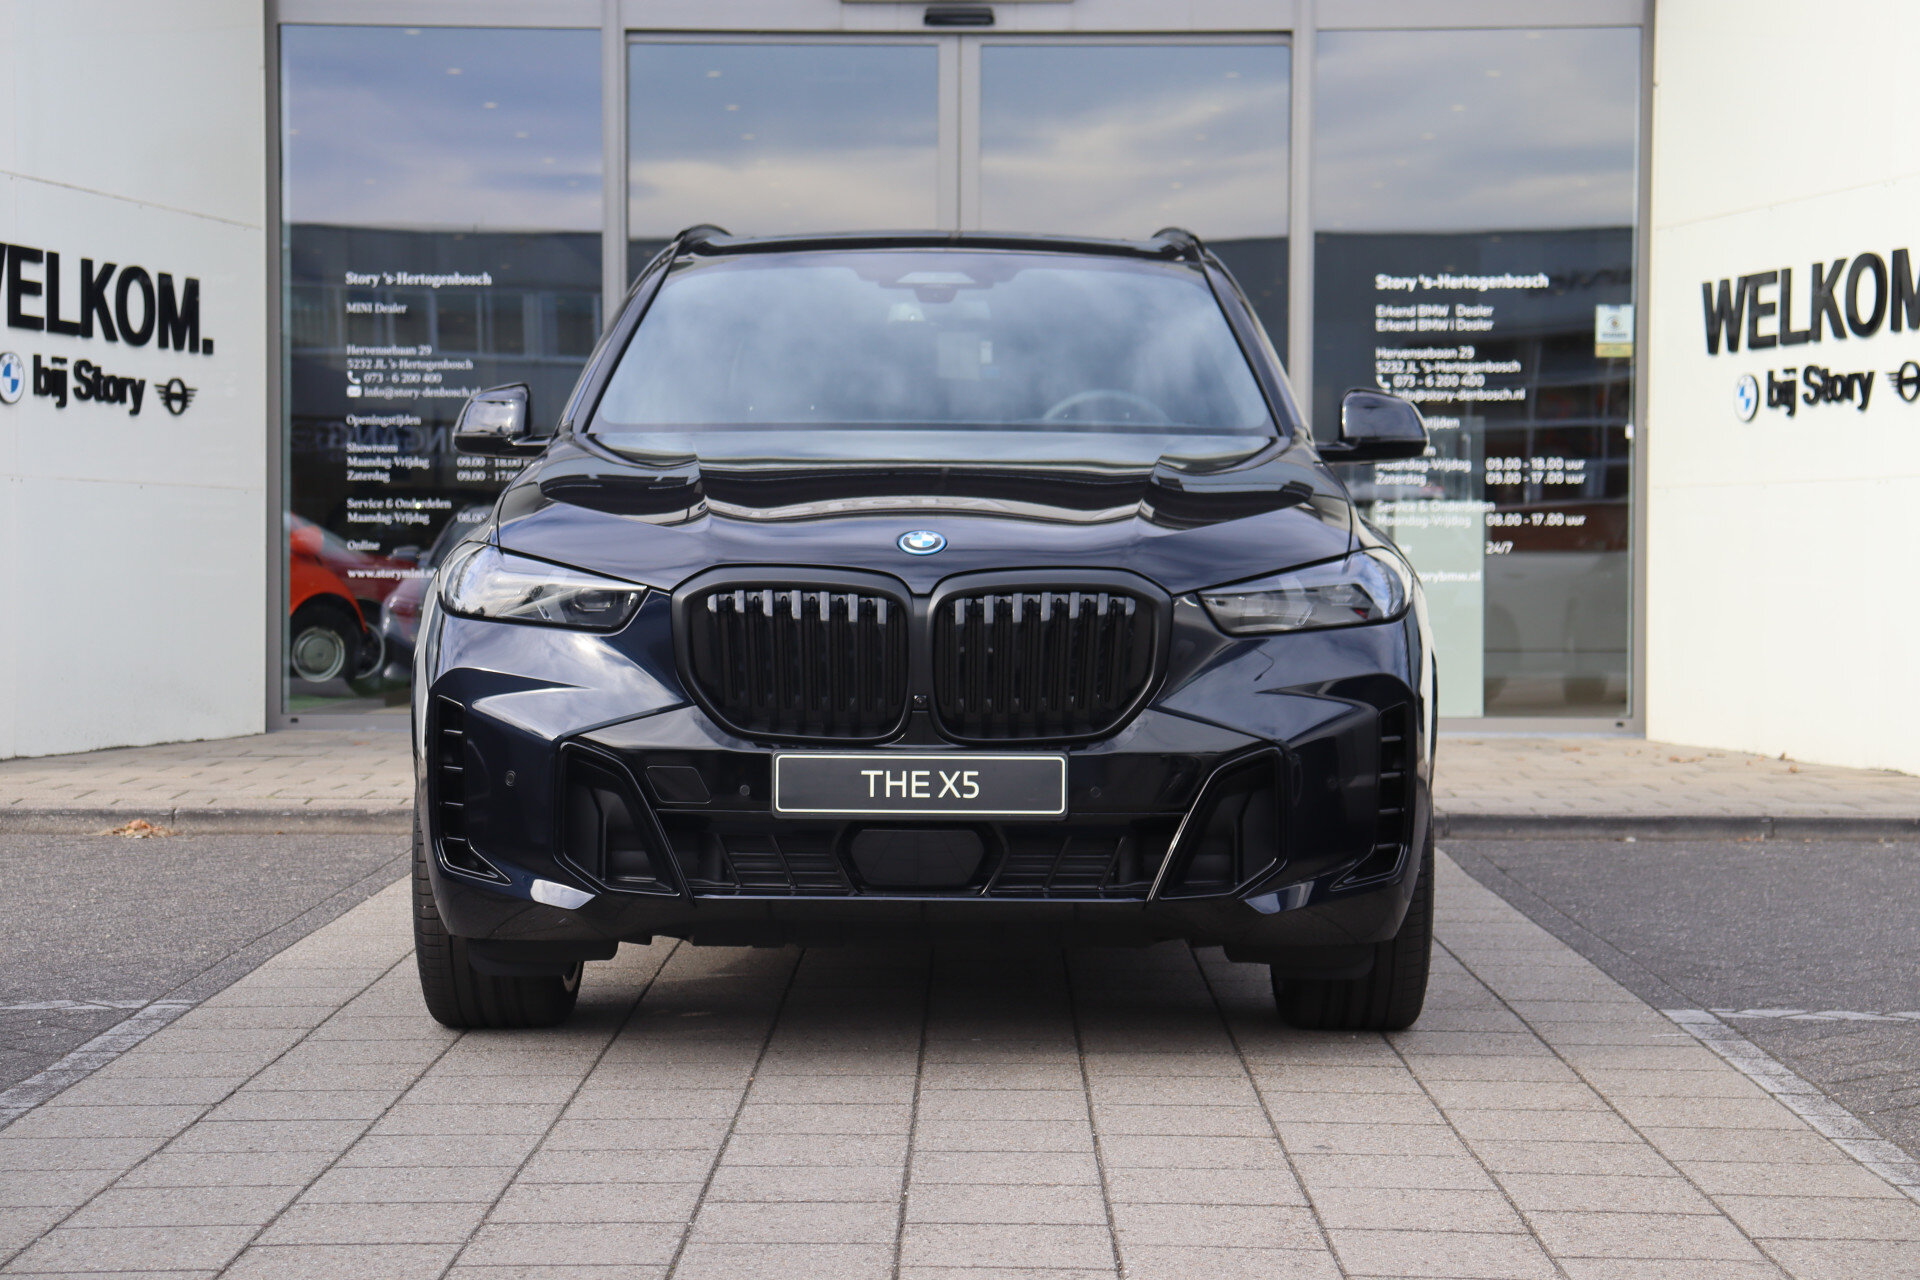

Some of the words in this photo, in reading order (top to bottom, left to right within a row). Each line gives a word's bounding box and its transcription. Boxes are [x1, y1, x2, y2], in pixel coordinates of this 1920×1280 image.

[345, 271, 380, 288] Story
[382, 271, 492, 288] 's-Hertogenbosch
[1375, 273, 1417, 292] Story
[1419, 273, 1549, 291] 's-Hertogenbosch
[0, 242, 214, 355] ELKOM.
[346, 302, 372, 314] MINI
[375, 302, 408, 314] Dealer
[1376, 304, 1416, 317] Erkend
[1417, 304, 1449, 317] BMW
[1455, 304, 1494, 317] Dealer
[1376, 318, 1416, 332] Erkend
[1417, 318, 1449, 332] BMW
[1455, 318, 1494, 332] Dealer
[418, 344, 432, 356] 29
[1458, 346, 1475, 359] 29
[347, 358, 372, 369] 5232
[1376, 361, 1405, 374] 5232
[363, 372, 383, 383] 073
[401, 372, 421, 383] 200
[422, 372, 442, 383] 400
[1393, 374, 1415, 387] 073
[1425, 374, 1434, 387] 6
[1435, 374, 1459, 387] 200
[1460, 374, 1485, 387] 400
[33, 354, 67, 408] bij
[73, 359, 146, 416] Story
[1767, 369, 1796, 418] bij
[1803, 365, 1875, 412] Story
[346, 414, 421, 427] Openingstijden
[346, 443, 398, 453] Showroom
[1485, 457, 1521, 470] 09.00
[1530, 457, 1564, 470] 18.00
[1565, 460, 1585, 470] uur
[347, 470, 390, 483] Zaterdag
[1375, 472, 1427, 487] Zaterdag
[1485, 471, 1521, 484] 09.00
[1565, 474, 1585, 484] uur
[347, 498, 384, 509] Service
[395, 497, 452, 509] Onderdelen
[1375, 501, 1417, 513] Service
[1430, 500, 1496, 513] Onderdelen
[1485, 513, 1522, 526] 08.00
[1565, 515, 1586, 526] uur
[347, 540, 380, 551] Online
[1485, 541, 1513, 555] 24/7
[861, 769, 931, 798] THE
[937, 769, 980, 799] X5
